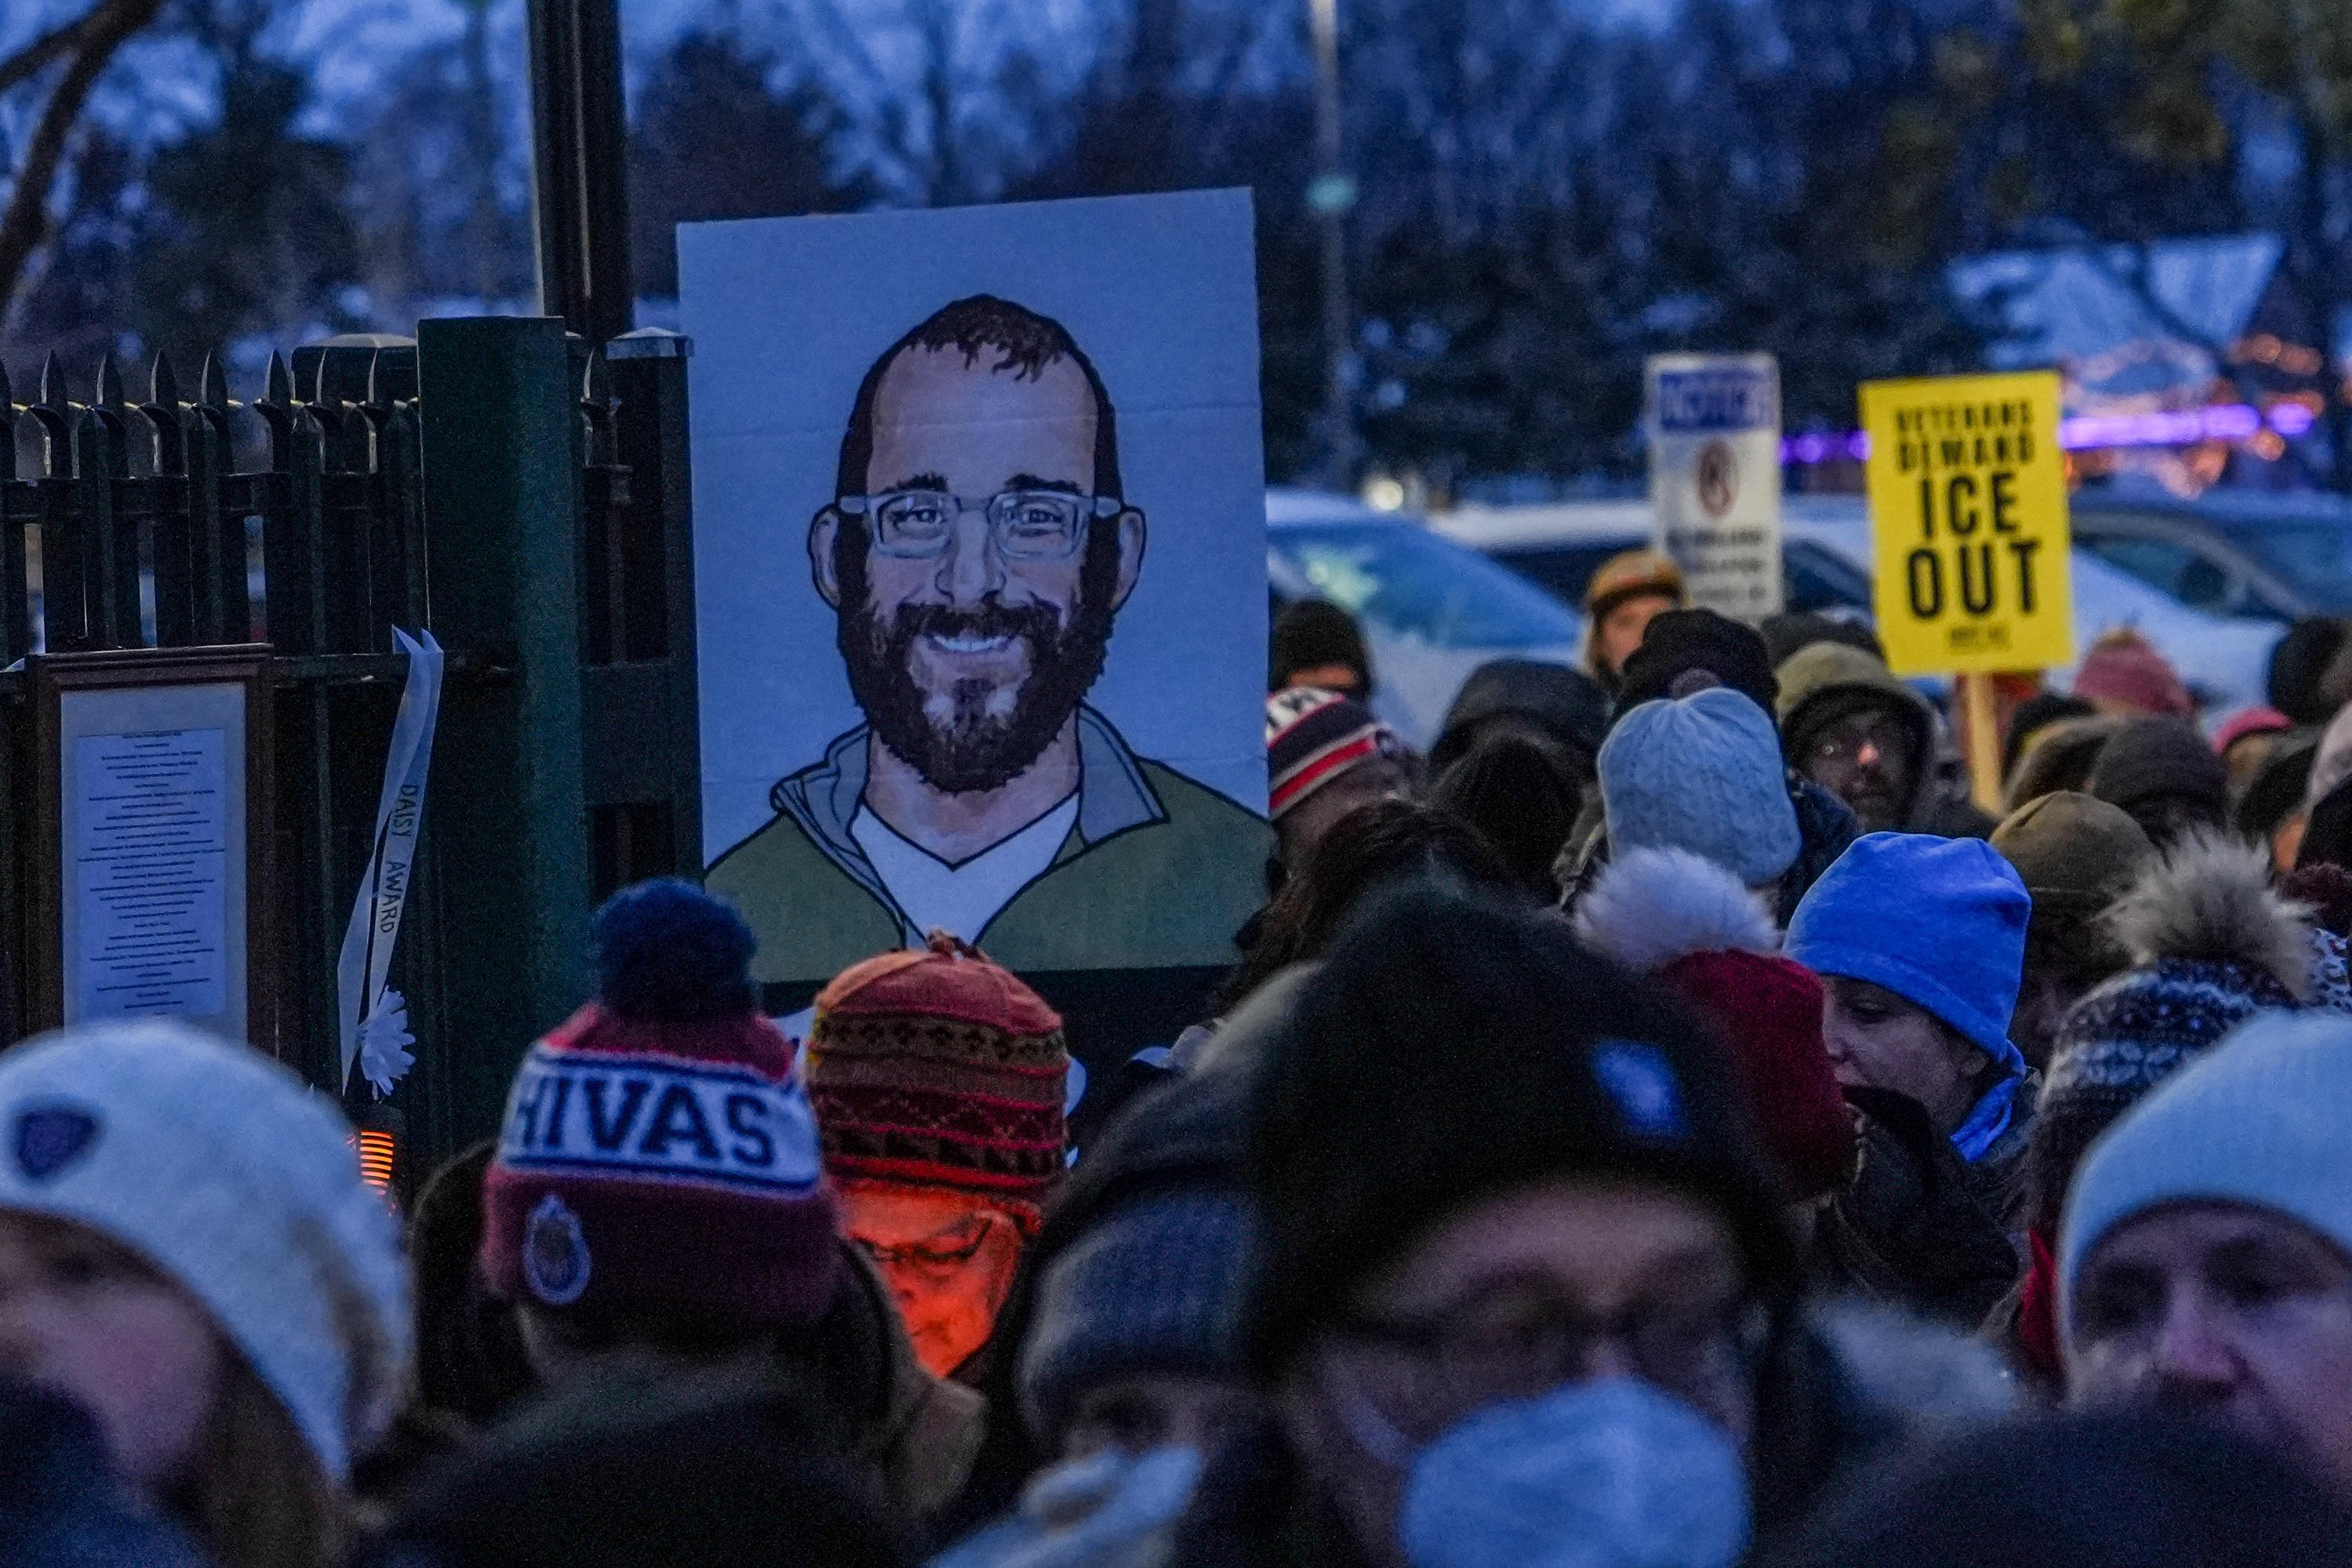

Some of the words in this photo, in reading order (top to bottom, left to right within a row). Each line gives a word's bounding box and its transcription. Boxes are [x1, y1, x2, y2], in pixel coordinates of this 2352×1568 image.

[1921, 472, 2020, 539] ICE
[1907, 539, 2042, 619] OUT
[392, 784, 420, 838] DAISY
[380, 860, 408, 934] AWARD
